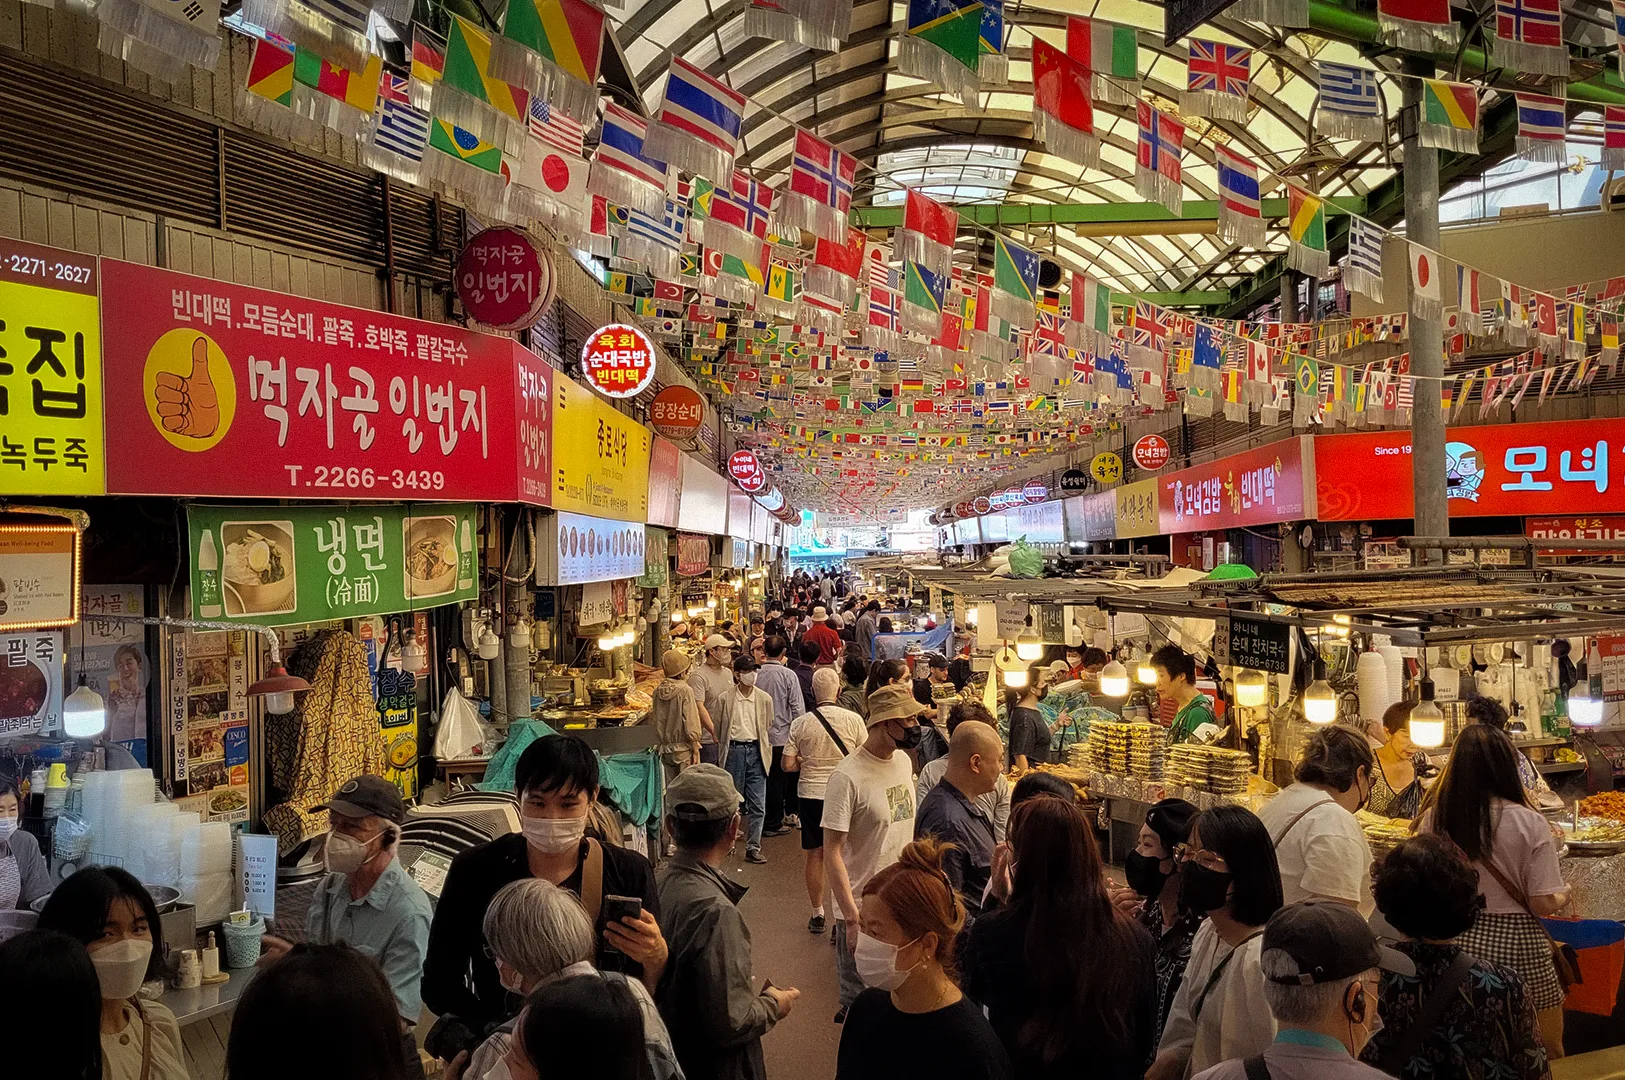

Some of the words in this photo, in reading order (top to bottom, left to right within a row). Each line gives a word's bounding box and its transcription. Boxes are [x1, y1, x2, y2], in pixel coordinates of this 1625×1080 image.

[463, 270, 532, 303] 일번지
[597, 335, 636, 349] 육회
[0, 318, 87, 420] 집
[588, 350, 647, 368] 순대국밥
[596, 368, 640, 384] 빈대떡
[518, 362, 548, 422] 먹자골
[654, 402, 701, 421] 광장순대
[520, 419, 548, 474] 일번지
[1137, 447, 1168, 459] 모녀김밥
[1374, 446, 1400, 456] Since
[1401, 445, 1413, 455] 19
[284, 465, 445, 491] T.2266-3439
[1501, 440, 1625, 494] 모녀
[1241, 464, 1275, 509] 빈대떡
[313, 516, 387, 576] 냉면
[201, 578, 217, 592] 장수
[326, 572, 380, 608] (冷面)
[1217, 635, 1227, 645] 64
[1233, 622, 1259, 635] 하니네
[1231, 636, 1249, 653] 순대
[1251, 637, 1287, 659] 잔치국수
[1239, 654, 1286, 672] 2268-6738
[382, 670, 416, 696] 장수
